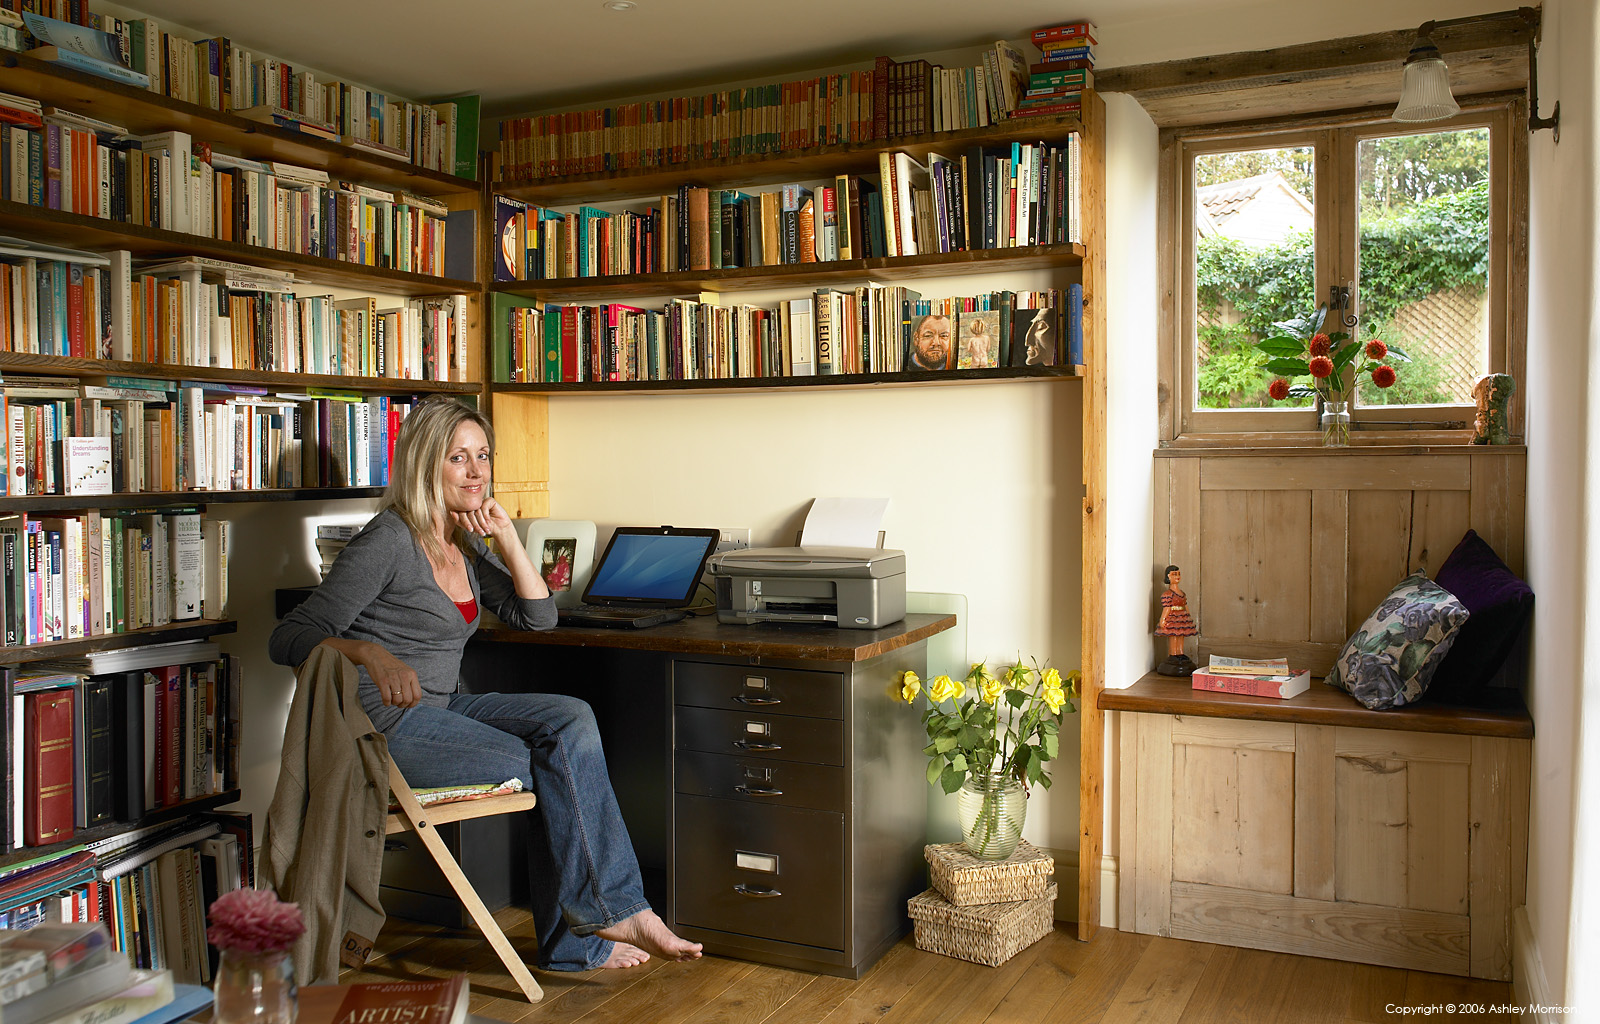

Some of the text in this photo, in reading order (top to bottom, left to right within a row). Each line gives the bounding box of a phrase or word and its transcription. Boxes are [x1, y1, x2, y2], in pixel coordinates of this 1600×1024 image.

[171, 65, 179, 89] BROWN
[31, 134, 41, 205] BEN ELTON STARK
[1042, 165, 1050, 185] Egyptian
[826, 190, 836, 211] India
[955, 196, 963, 218] Sculpture
[1021, 169, 1030, 218] Reading Egyptian Art
[787, 212, 798, 264] CAMBRIDGE
[231, 280, 258, 290] Ali Smith
[819, 325, 831, 360] ELIOT
[362, 405, 370, 441] CENTERING
[14, 418, 25, 465] THE DIETER
[90, 541, 101, 582] HERBAL
[103, 538, 111, 569] HERBAL
[198, 696, 208, 751] Healing Plants
[171, 727, 180, 766] GARDENING
[121, 882, 129, 919] DECORATIVE
